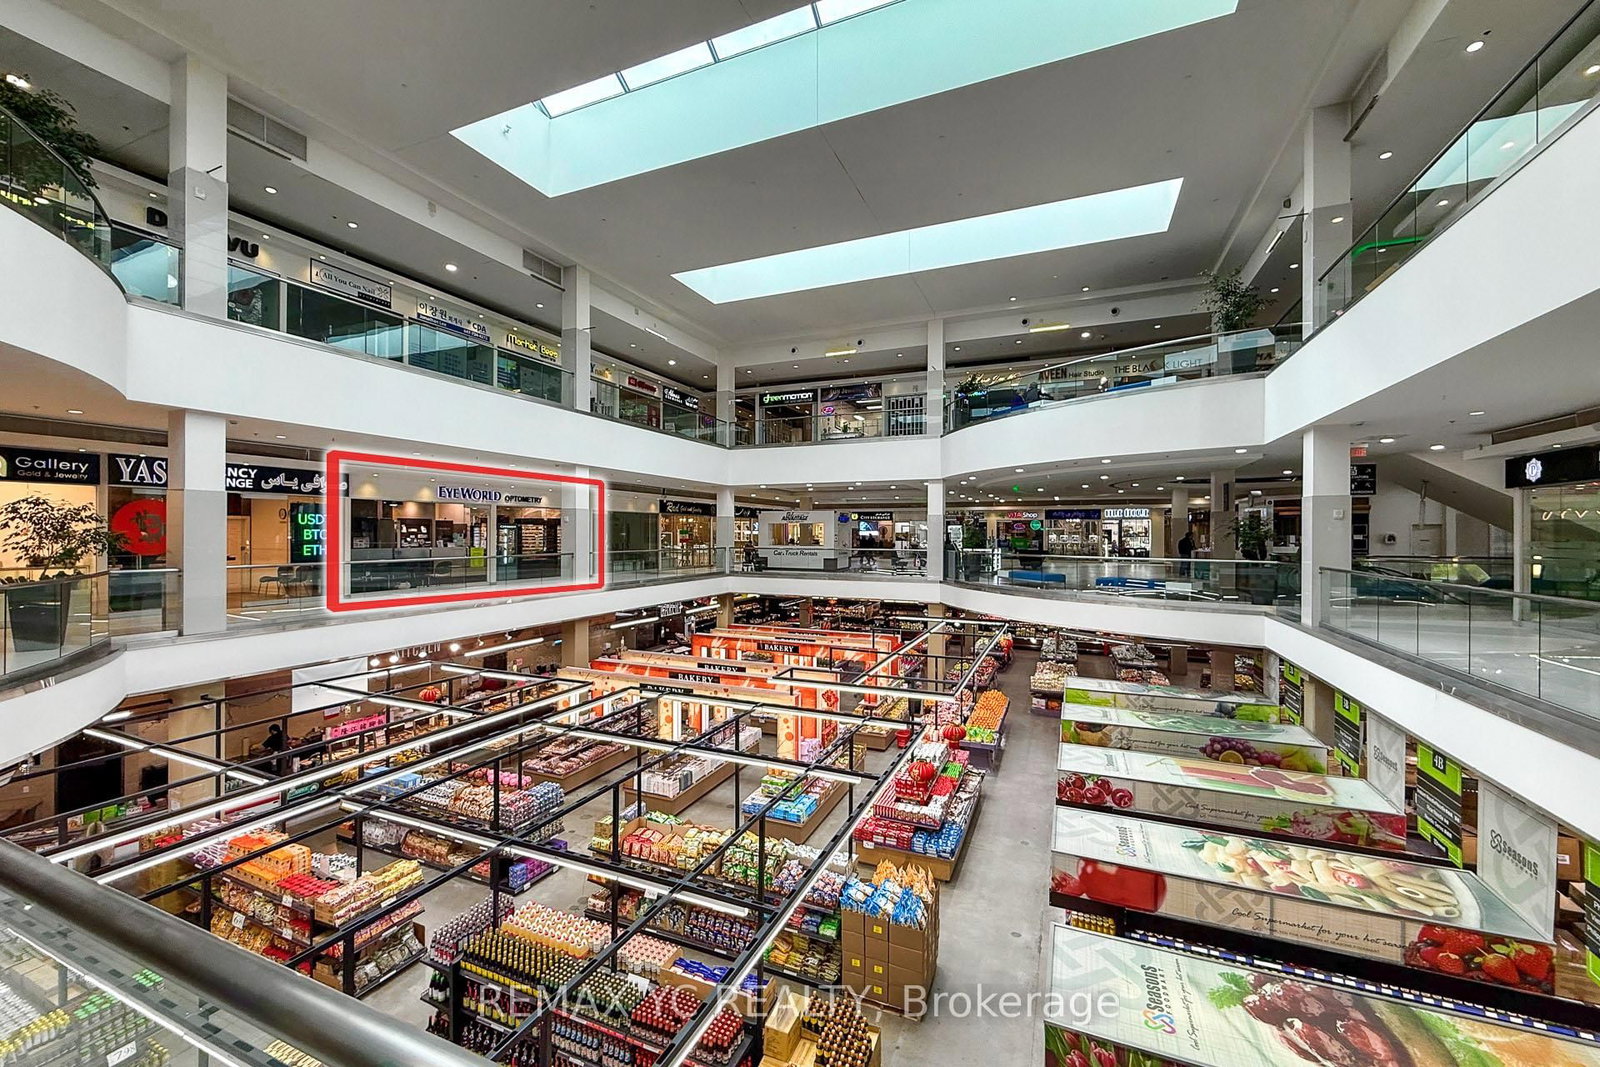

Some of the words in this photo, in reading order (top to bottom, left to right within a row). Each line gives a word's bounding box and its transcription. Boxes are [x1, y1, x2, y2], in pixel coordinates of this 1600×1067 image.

[323, 272, 333, 280] All
[334, 275, 347, 285] You
[348, 280, 361, 290] Can
[362, 286, 376, 295] Nail
[472, 322, 487, 333] CPA
[1114, 365, 1130, 374] THE
[1172, 358, 1203, 369] LIGHT
[1068, 370, 1083, 379] Hair
[1083, 369, 1105, 378] Studio
[15, 456, 89, 473] Gallery
[118, 457, 167, 484] YAS
[17, 469, 41, 477] Gold
[54, 472, 88, 480] Jewelry
[227, 467, 257, 479] NCY
[504, 495, 543, 504] OPTOMETRY
[298, 513, 326, 525] USD
[1022, 511, 1038, 519] Shop
[764, 643, 794, 653] BAKERY
[678, 673, 714, 683] BAKERY
[1433, 754, 1445, 770] 4B
[1200, 803, 1244, 816] Supermarket
[1243, 811, 1256, 819] for
[1231, 907, 1252, 919] Cool
[1253, 911, 1317, 931] Supermarket
[1316, 924, 1333, 937] for
[1335, 930, 1360, 942] your
[1362, 933, 1381, 945] hot
[1158, 967, 1173, 1016] FOODMART
